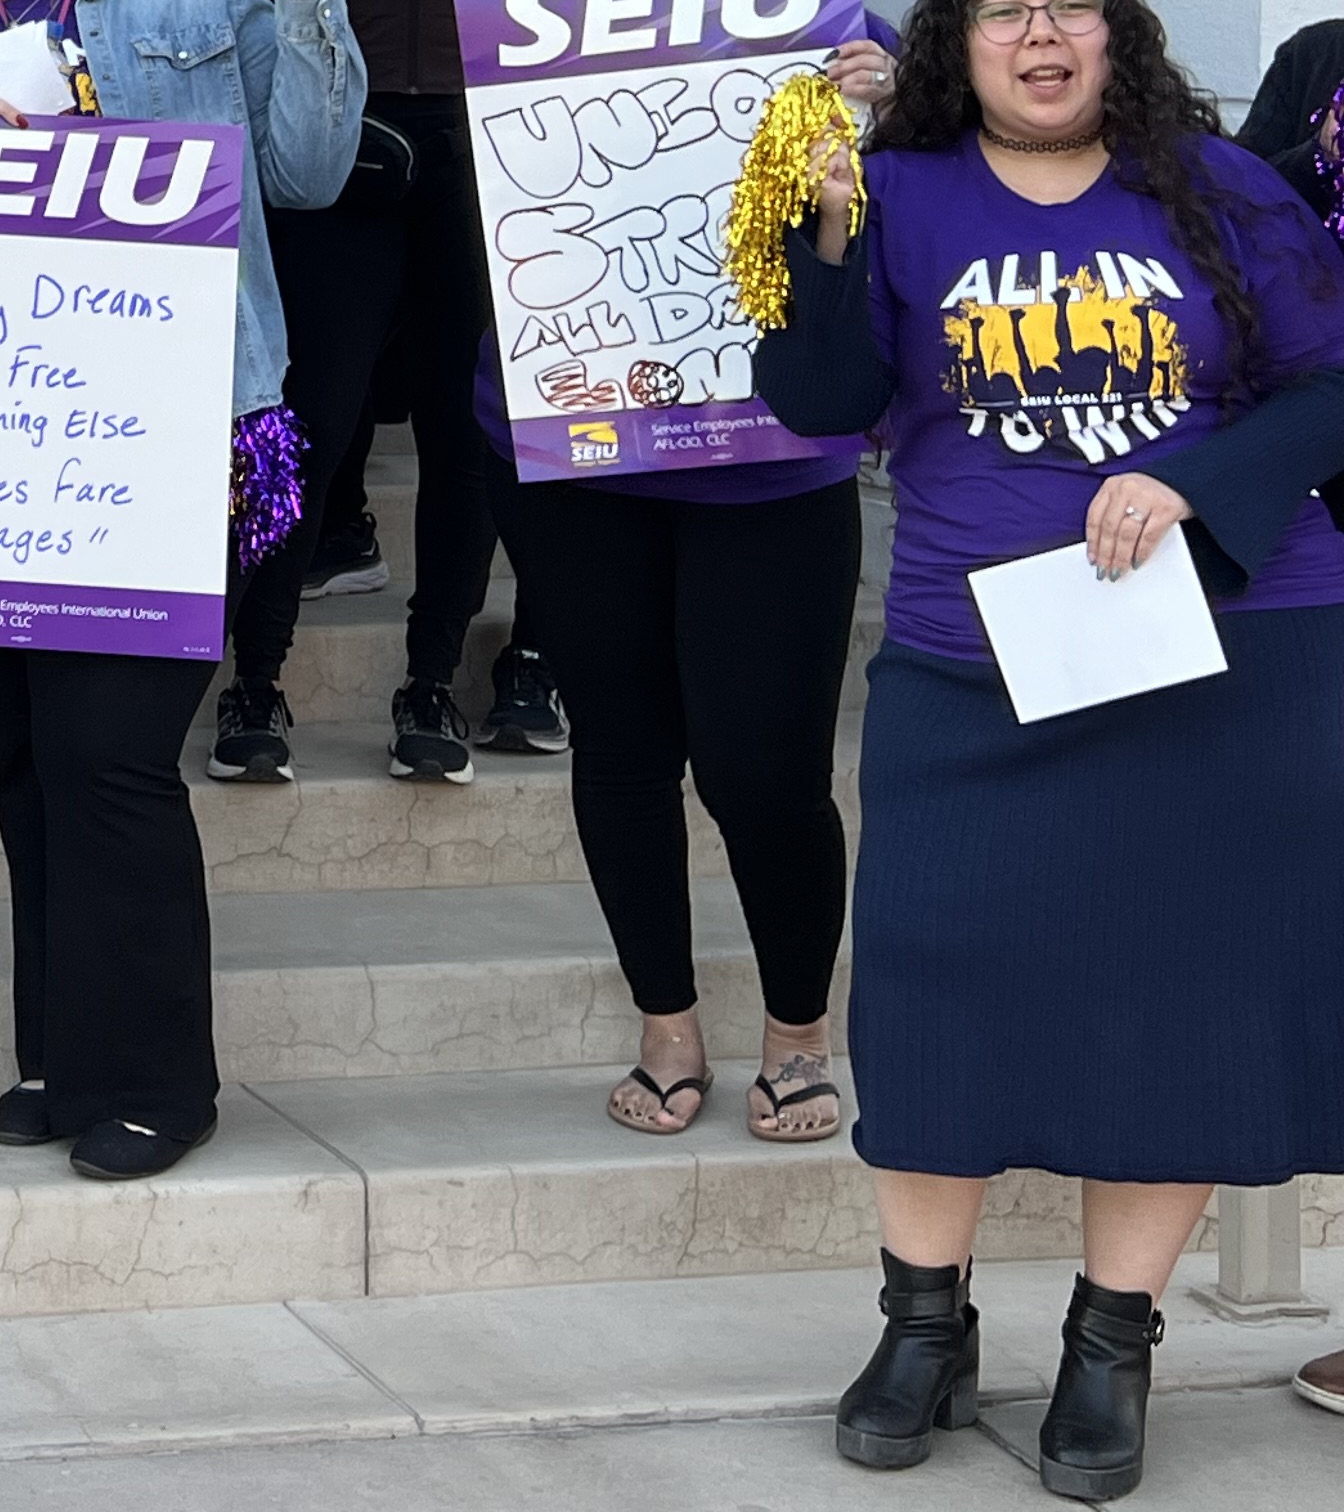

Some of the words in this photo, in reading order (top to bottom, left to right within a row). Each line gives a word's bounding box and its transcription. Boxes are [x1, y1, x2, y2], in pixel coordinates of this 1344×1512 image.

[31, 273, 174, 322] Dreams
[941, 251, 1083, 309] ALL
[1095, 251, 1184, 299] IN
[509, 301, 637, 362] ALL
[8, 345, 87, 389] Free
[64, 408, 148, 439] Else
[571, 443, 619, 462] SEIU
[0, 600, 59, 617] Employees
[61, 602, 131, 619] International
[133, 607, 168, 621] Union
[10, 614, 32, 629] CLC
